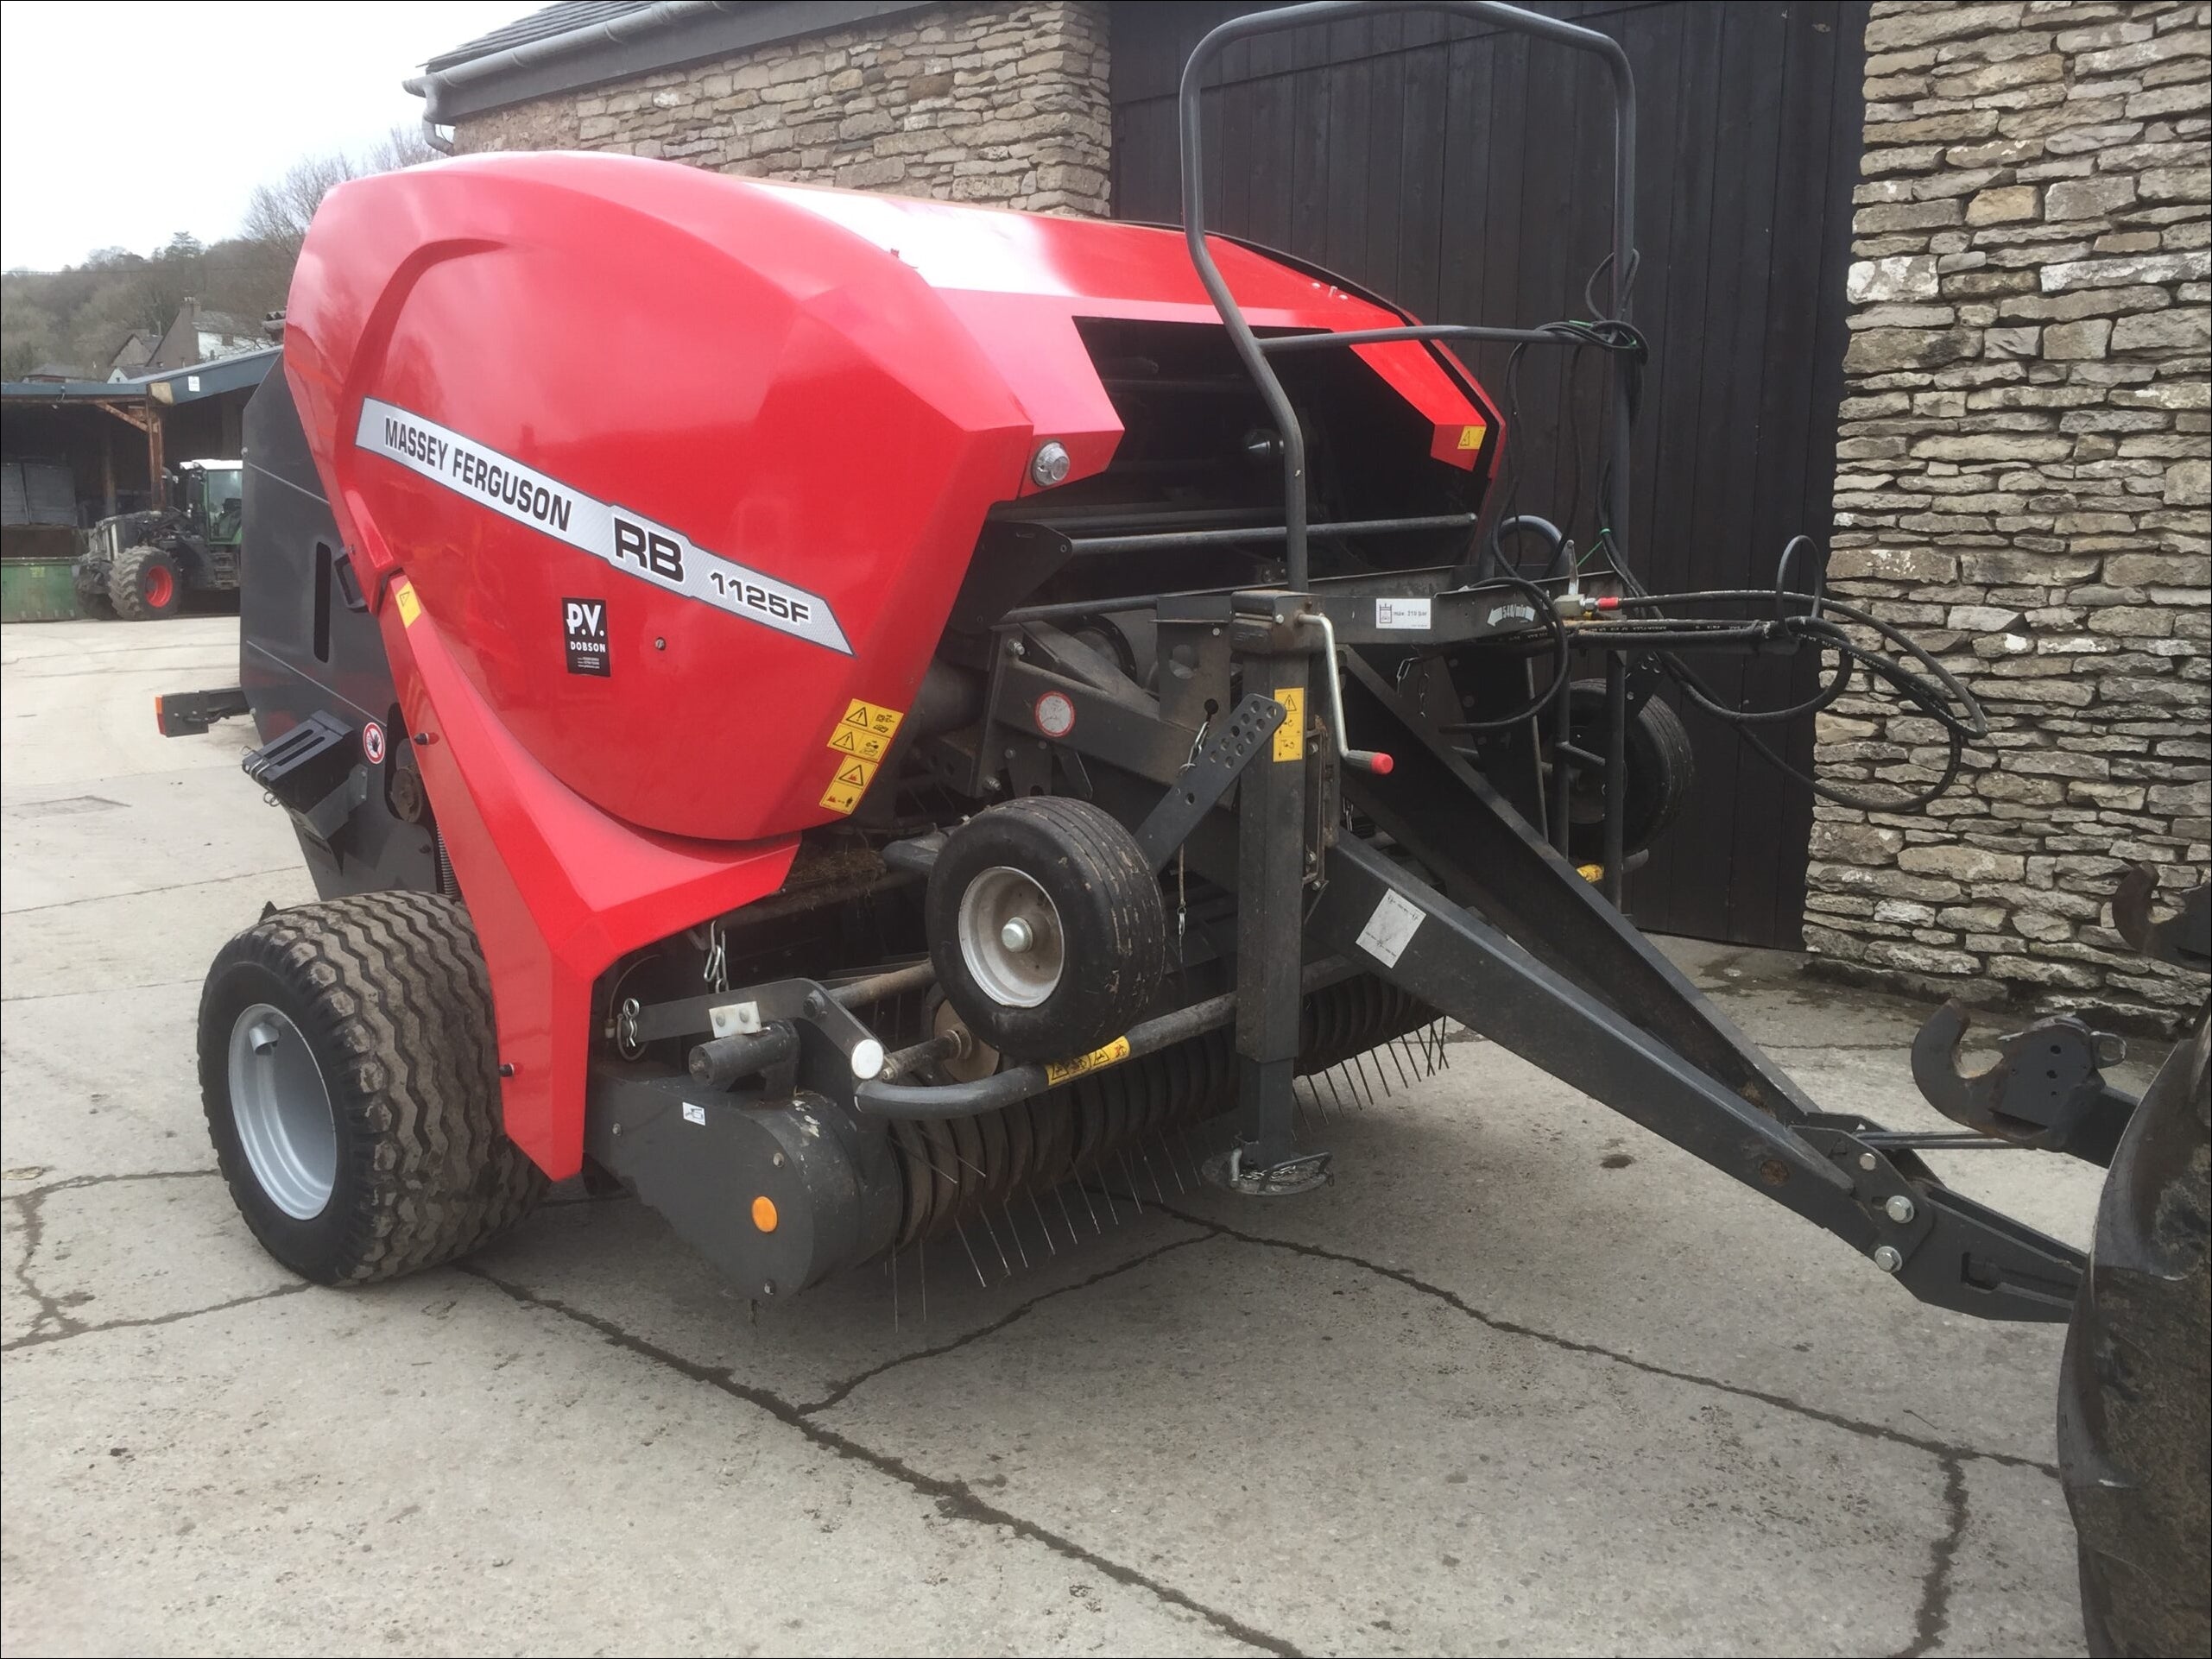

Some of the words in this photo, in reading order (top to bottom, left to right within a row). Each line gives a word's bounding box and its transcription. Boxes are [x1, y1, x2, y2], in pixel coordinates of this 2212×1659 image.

[385, 418, 449, 470] MASSEY
[452, 448, 572, 532] FERGUSON
[614, 517, 684, 583] RB
[710, 572, 809, 622] 1125F
[566, 602, 605, 637] P.V.
[570, 640, 606, 653] DOBSON
